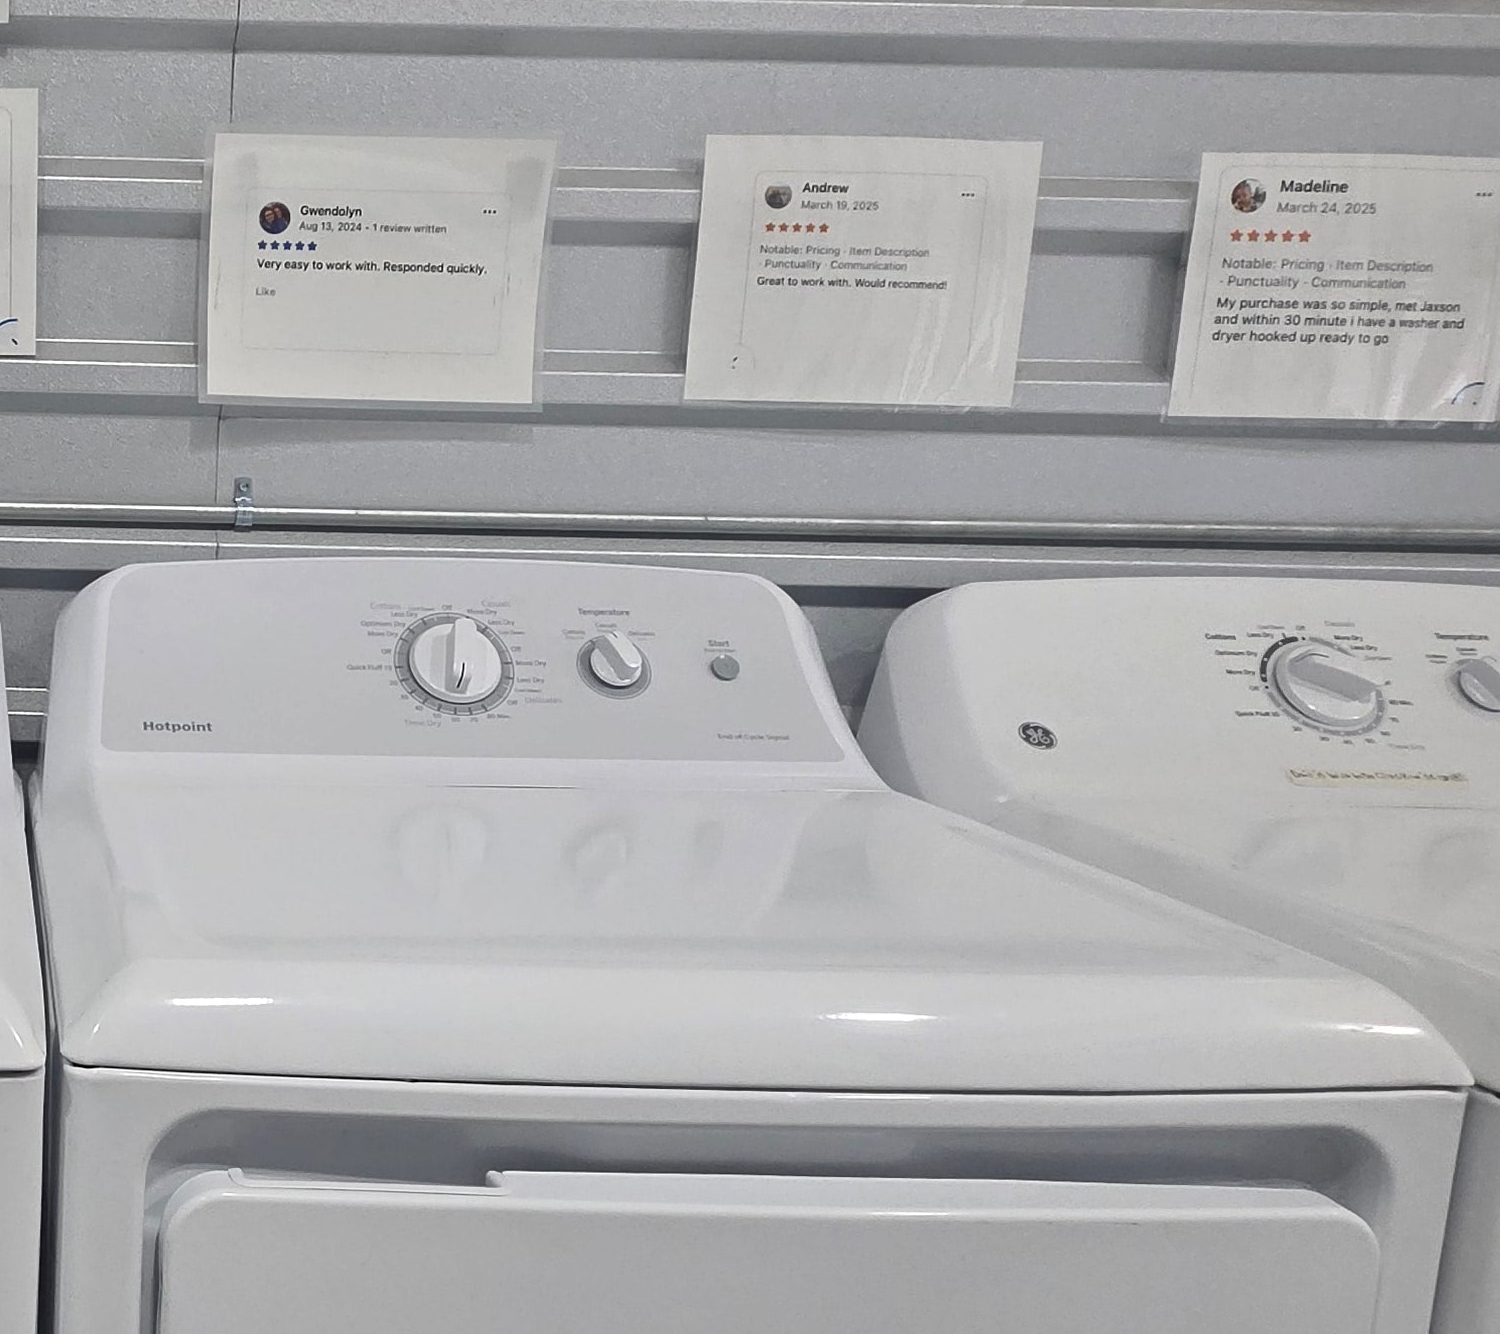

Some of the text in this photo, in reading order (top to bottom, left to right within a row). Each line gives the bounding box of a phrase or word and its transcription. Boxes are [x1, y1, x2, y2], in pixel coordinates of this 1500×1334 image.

[801, 181, 849, 193] Andrew
[1279, 179, 1349, 193] Madeline
[300, 205, 362, 219] Gwendolyn
[1276, 201, 1318, 213] March
[1319, 201, 1340, 216] 24,
[256, 258, 487, 276] Very easy to work with. Responded quickly.
[756, 276, 785, 286] Great
[787, 277, 799, 287] to
[800, 276, 825, 286] work
[827, 278, 852, 287] with.
[854, 278, 886, 288] Would
[1211, 329, 1389, 346] dryer hooked up ready to go
[142, 721, 212, 733] Hotpoint
